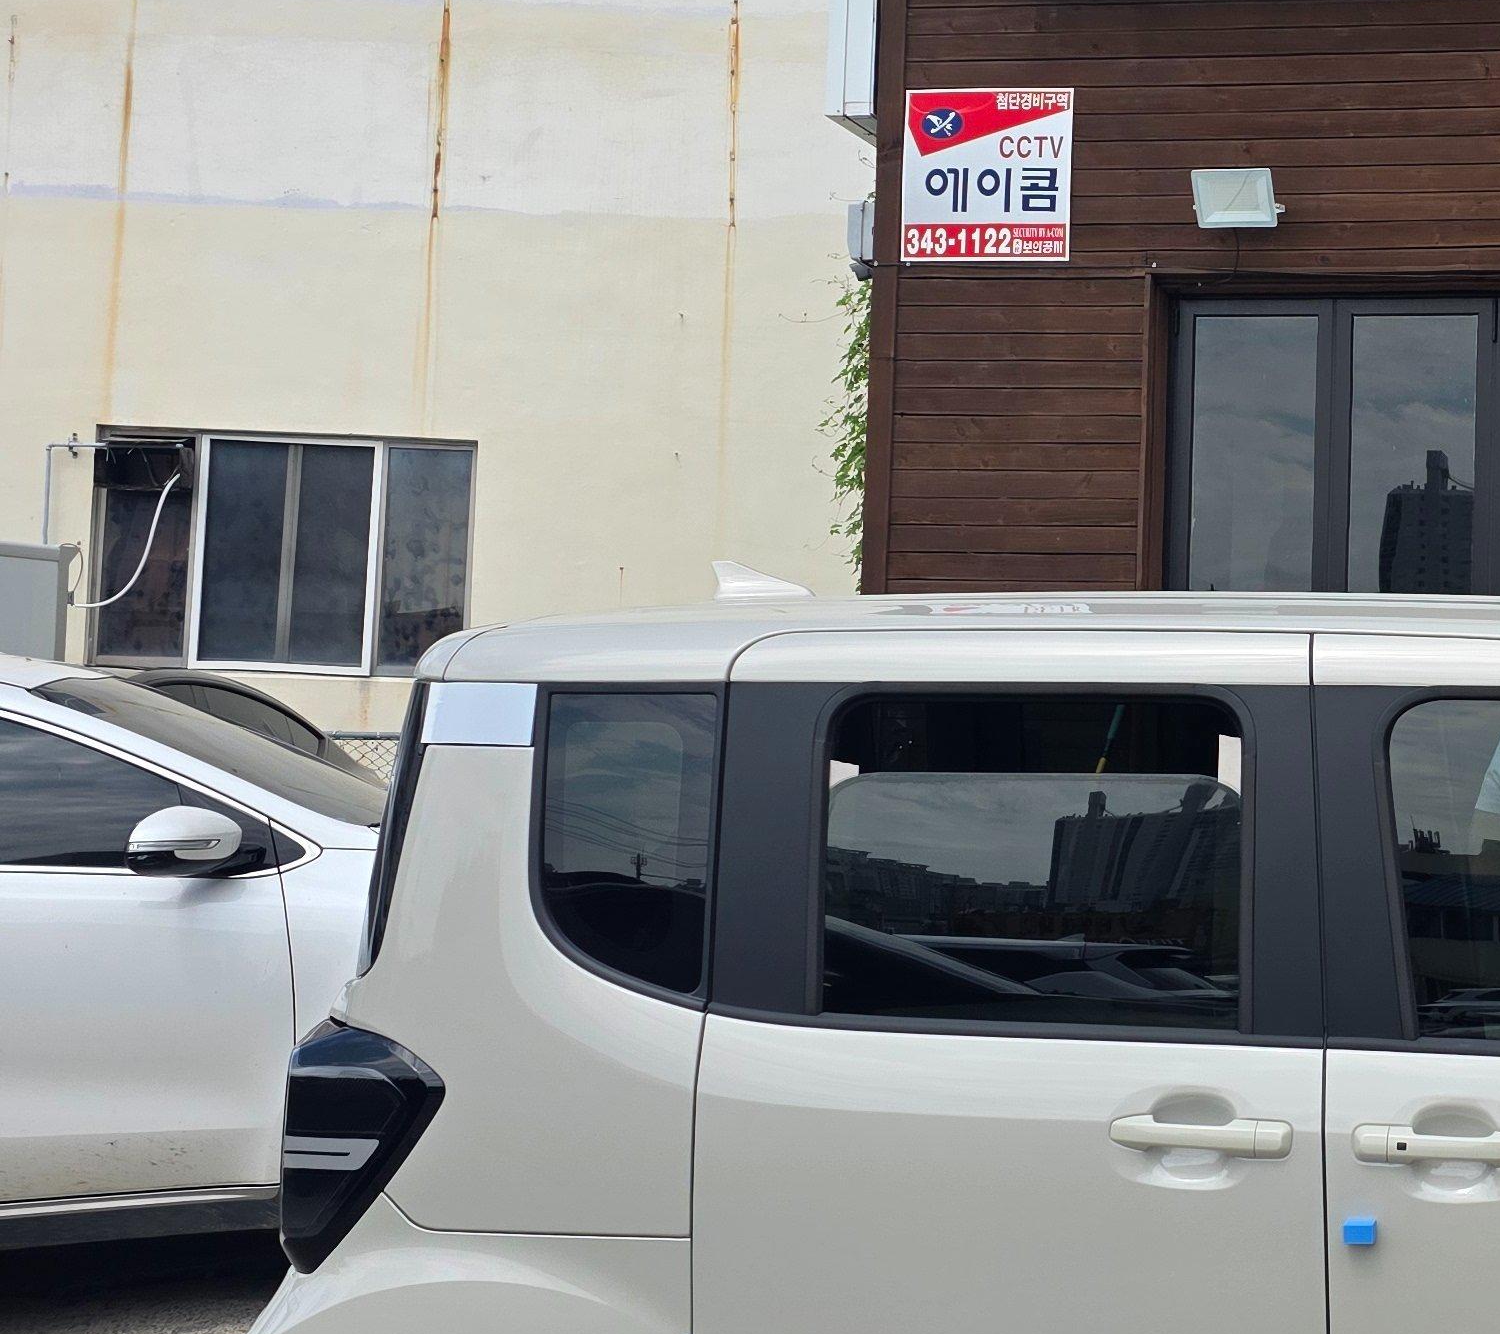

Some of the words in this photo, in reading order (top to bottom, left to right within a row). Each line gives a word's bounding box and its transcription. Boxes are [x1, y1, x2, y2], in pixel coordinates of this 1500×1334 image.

[996, 92, 1070, 110] 첨단경비구역
[999, 135, 1064, 159] CCTV
[925, 167, 1059, 213] 에이콤
[906, 227, 1012, 255] 343-1122
